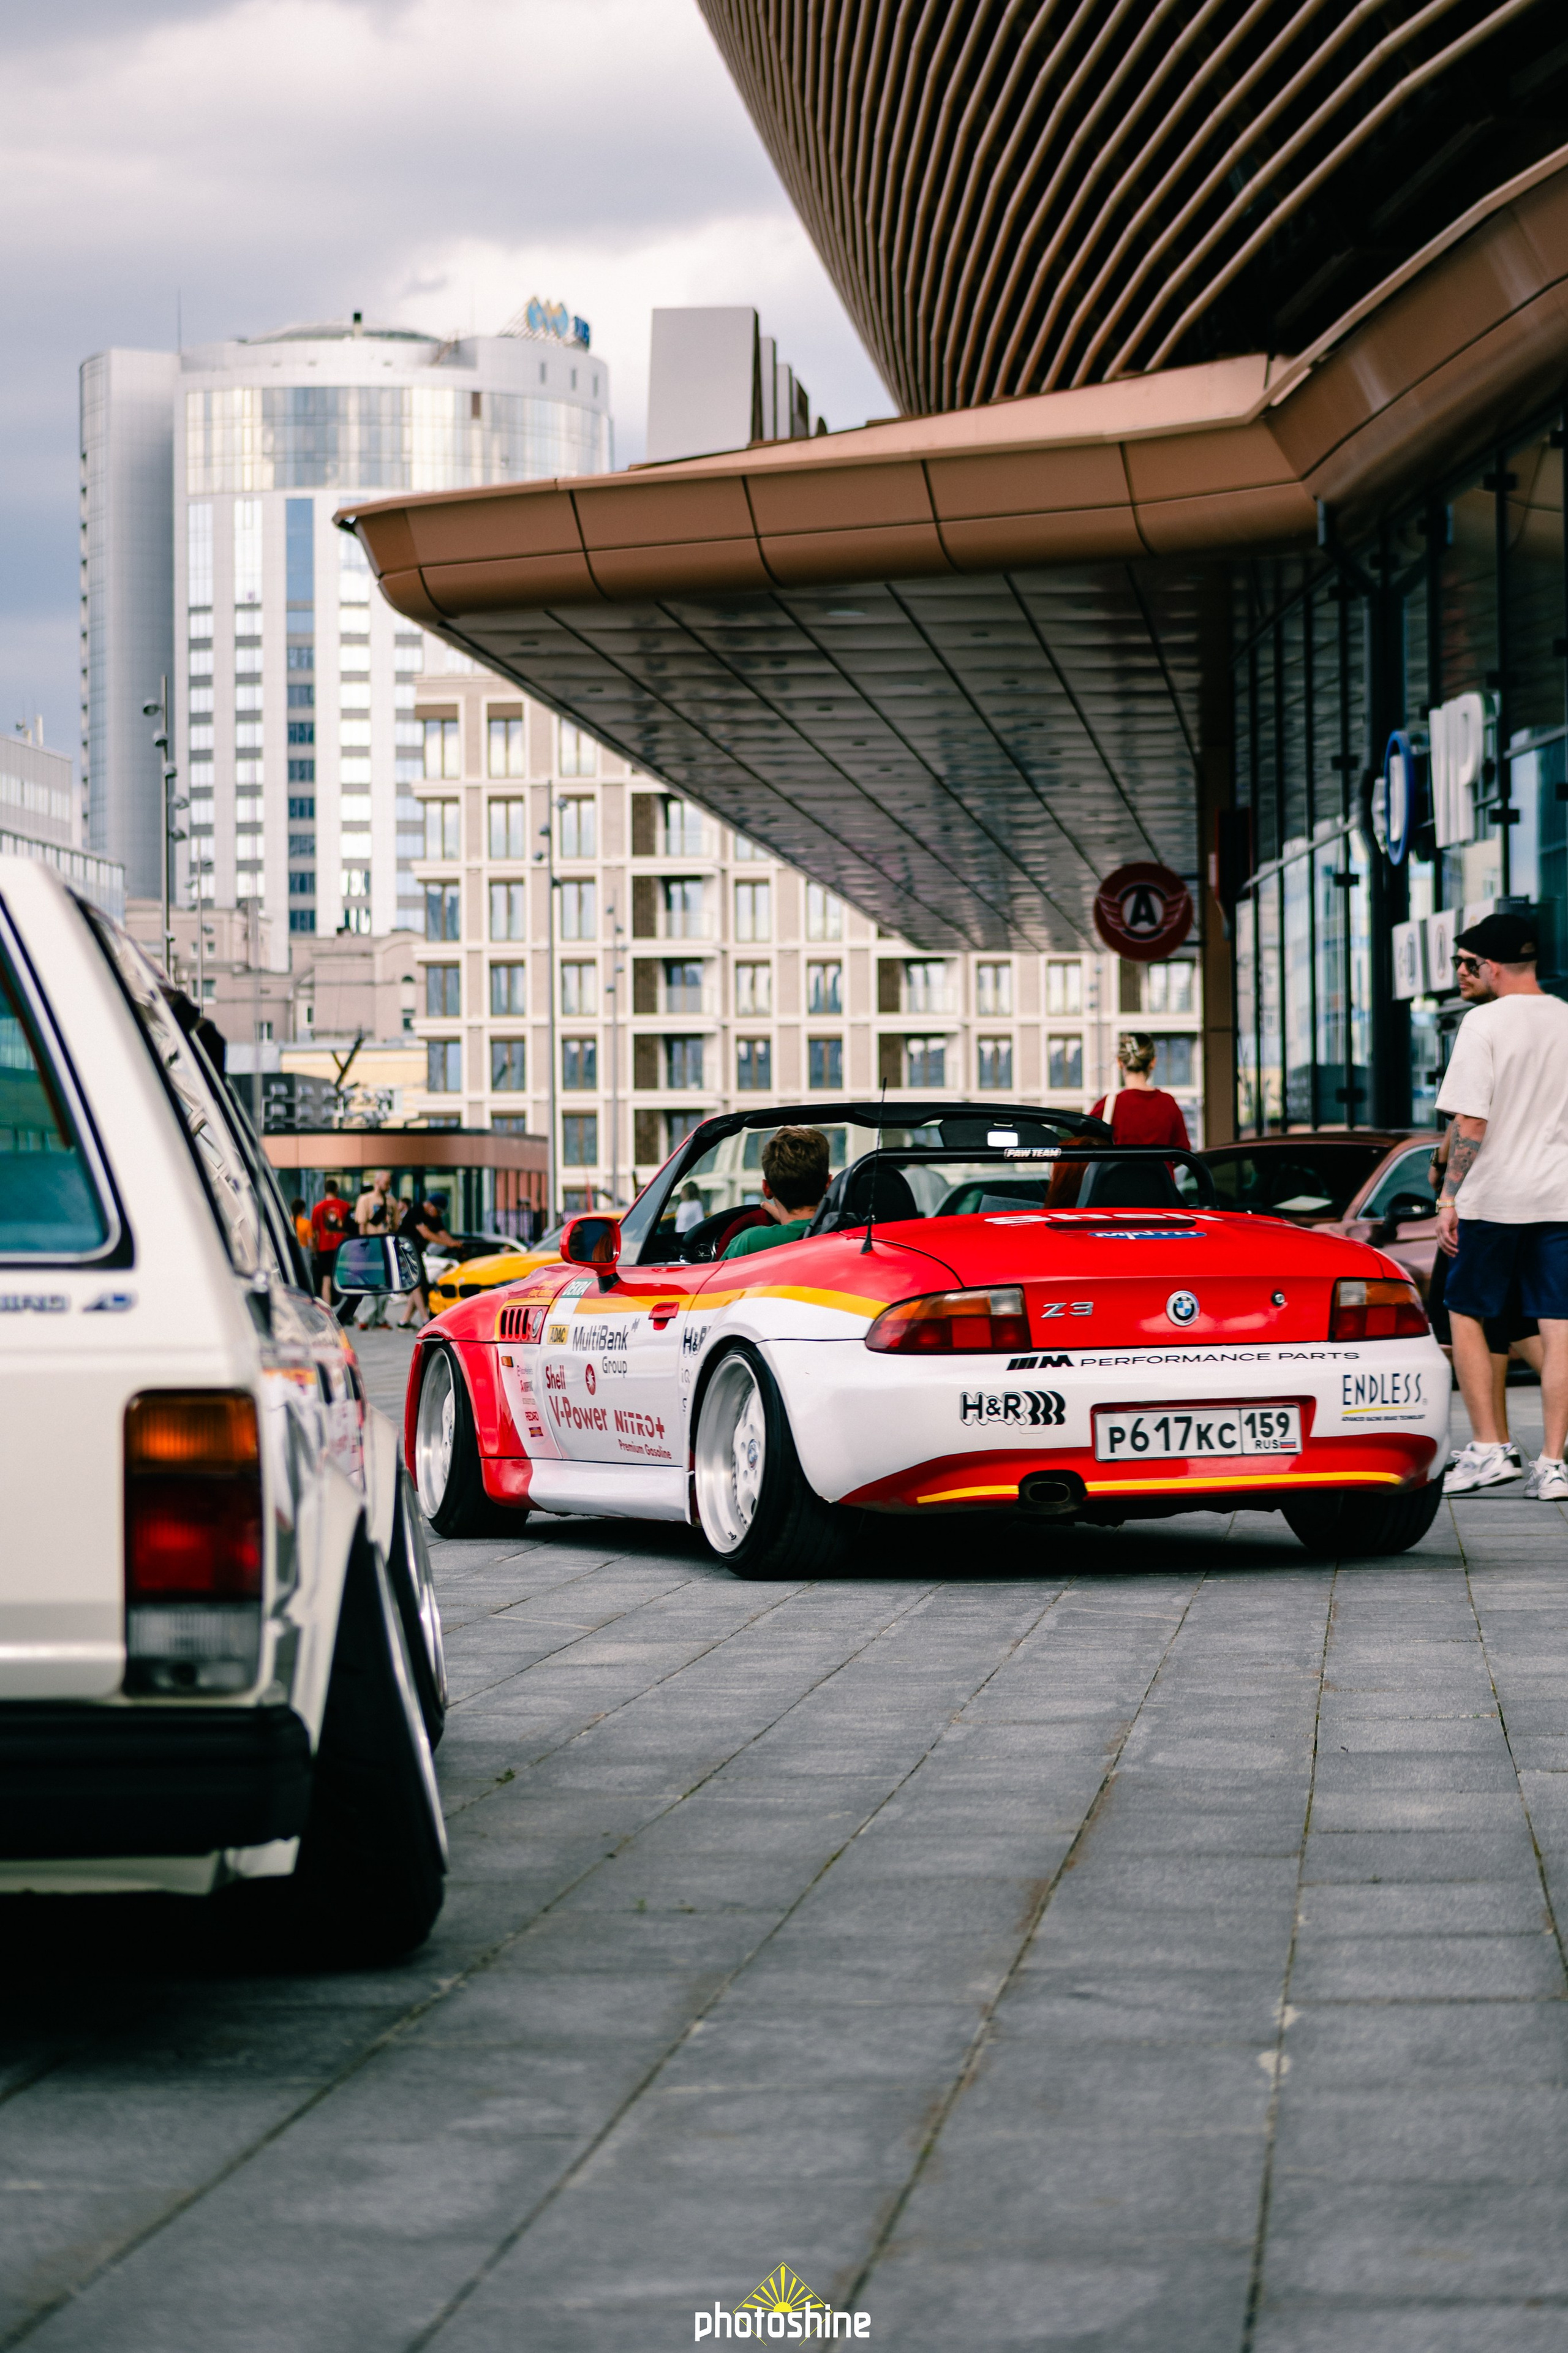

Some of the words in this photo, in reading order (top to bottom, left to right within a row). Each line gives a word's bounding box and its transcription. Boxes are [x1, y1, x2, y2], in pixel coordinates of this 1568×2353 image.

[984, 1213, 1224, 1225] Shell
[562, 1281, 592, 1296] DEKRA
[1041, 1302, 1094, 1318] Z3
[550, 1327, 566, 1343] ADAC
[572, 1325, 628, 1351] MultiBank
[602, 1356, 627, 1378] Group
[1080, 1353, 1270, 1367] PERFORMANCE
[546, 1364, 566, 1389] Shell
[1343, 1373, 1422, 1405] ENDLESS
[549, 1395, 608, 1431] V-Power
[961, 1392, 1024, 1422] H&R
[1244, 1412, 1290, 1438] 159
[618, 1439, 644, 1454] Premium
[645, 1444, 672, 1459] Gasoline
[1255, 1439, 1280, 1449] RUS
